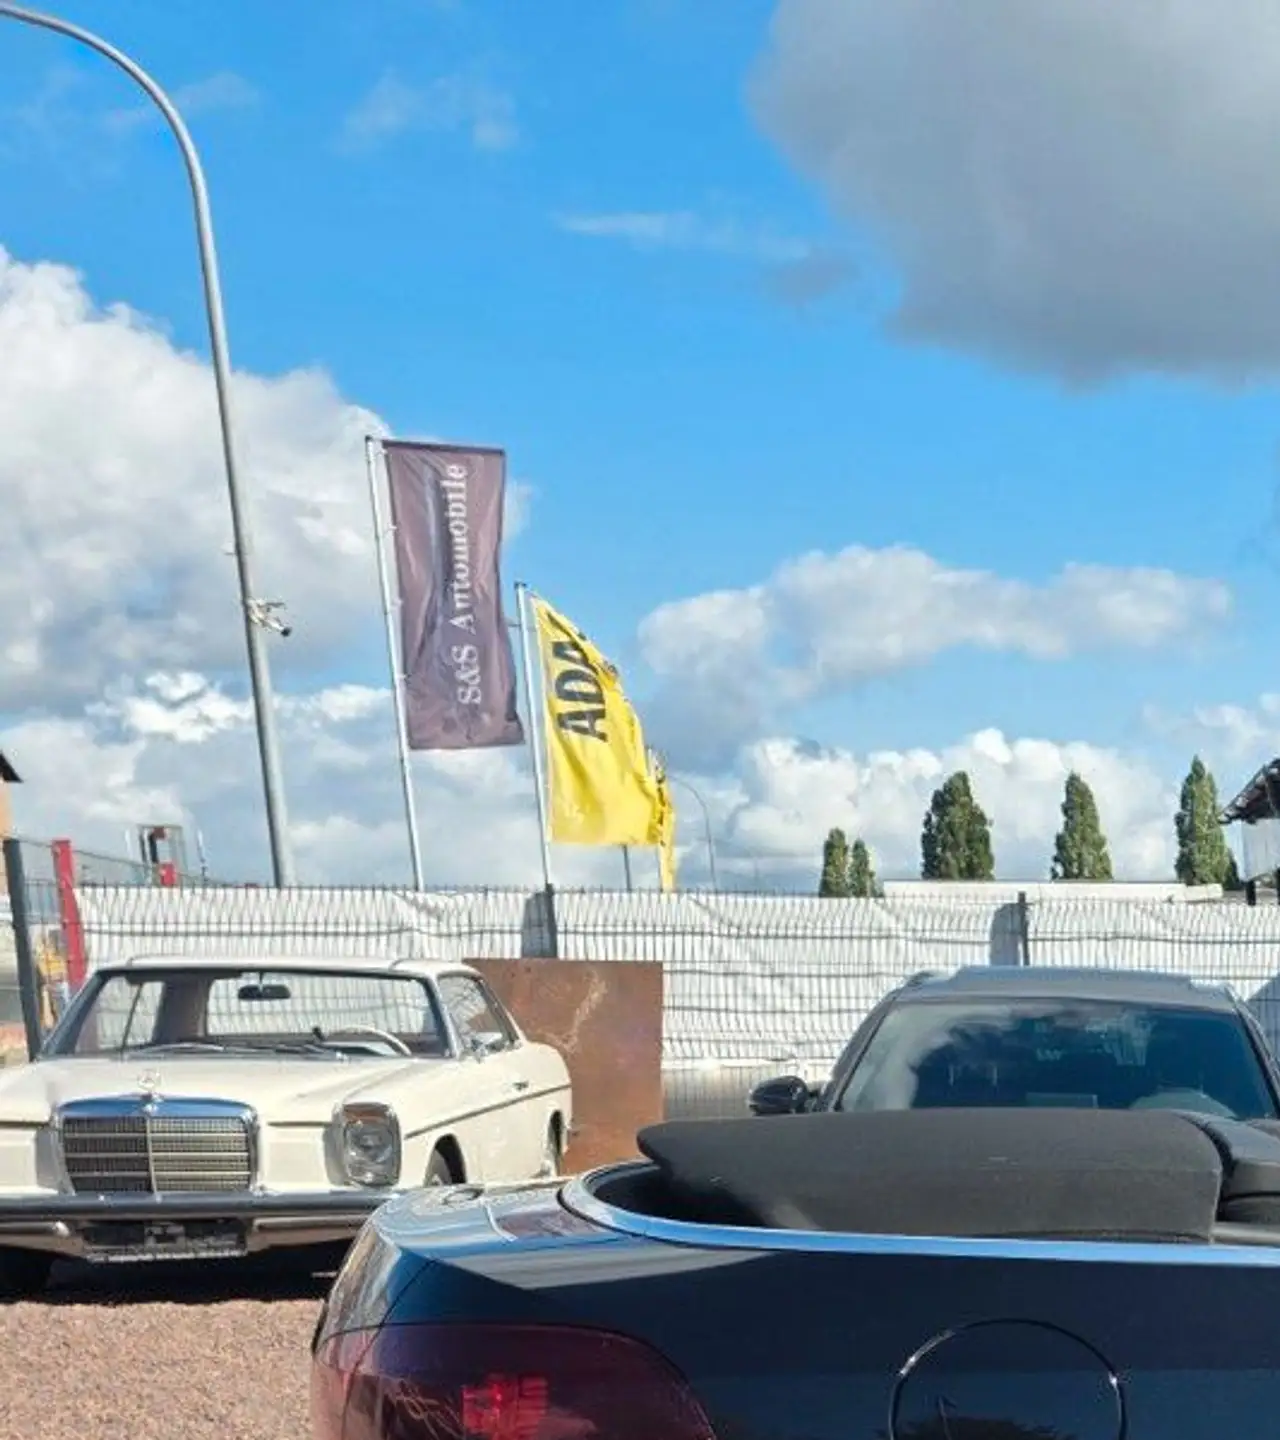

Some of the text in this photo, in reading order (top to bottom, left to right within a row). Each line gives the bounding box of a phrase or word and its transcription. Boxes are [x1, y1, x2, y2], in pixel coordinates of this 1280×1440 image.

[440, 464, 481, 704] S&S Automobile
[548, 614, 608, 743] ADA
